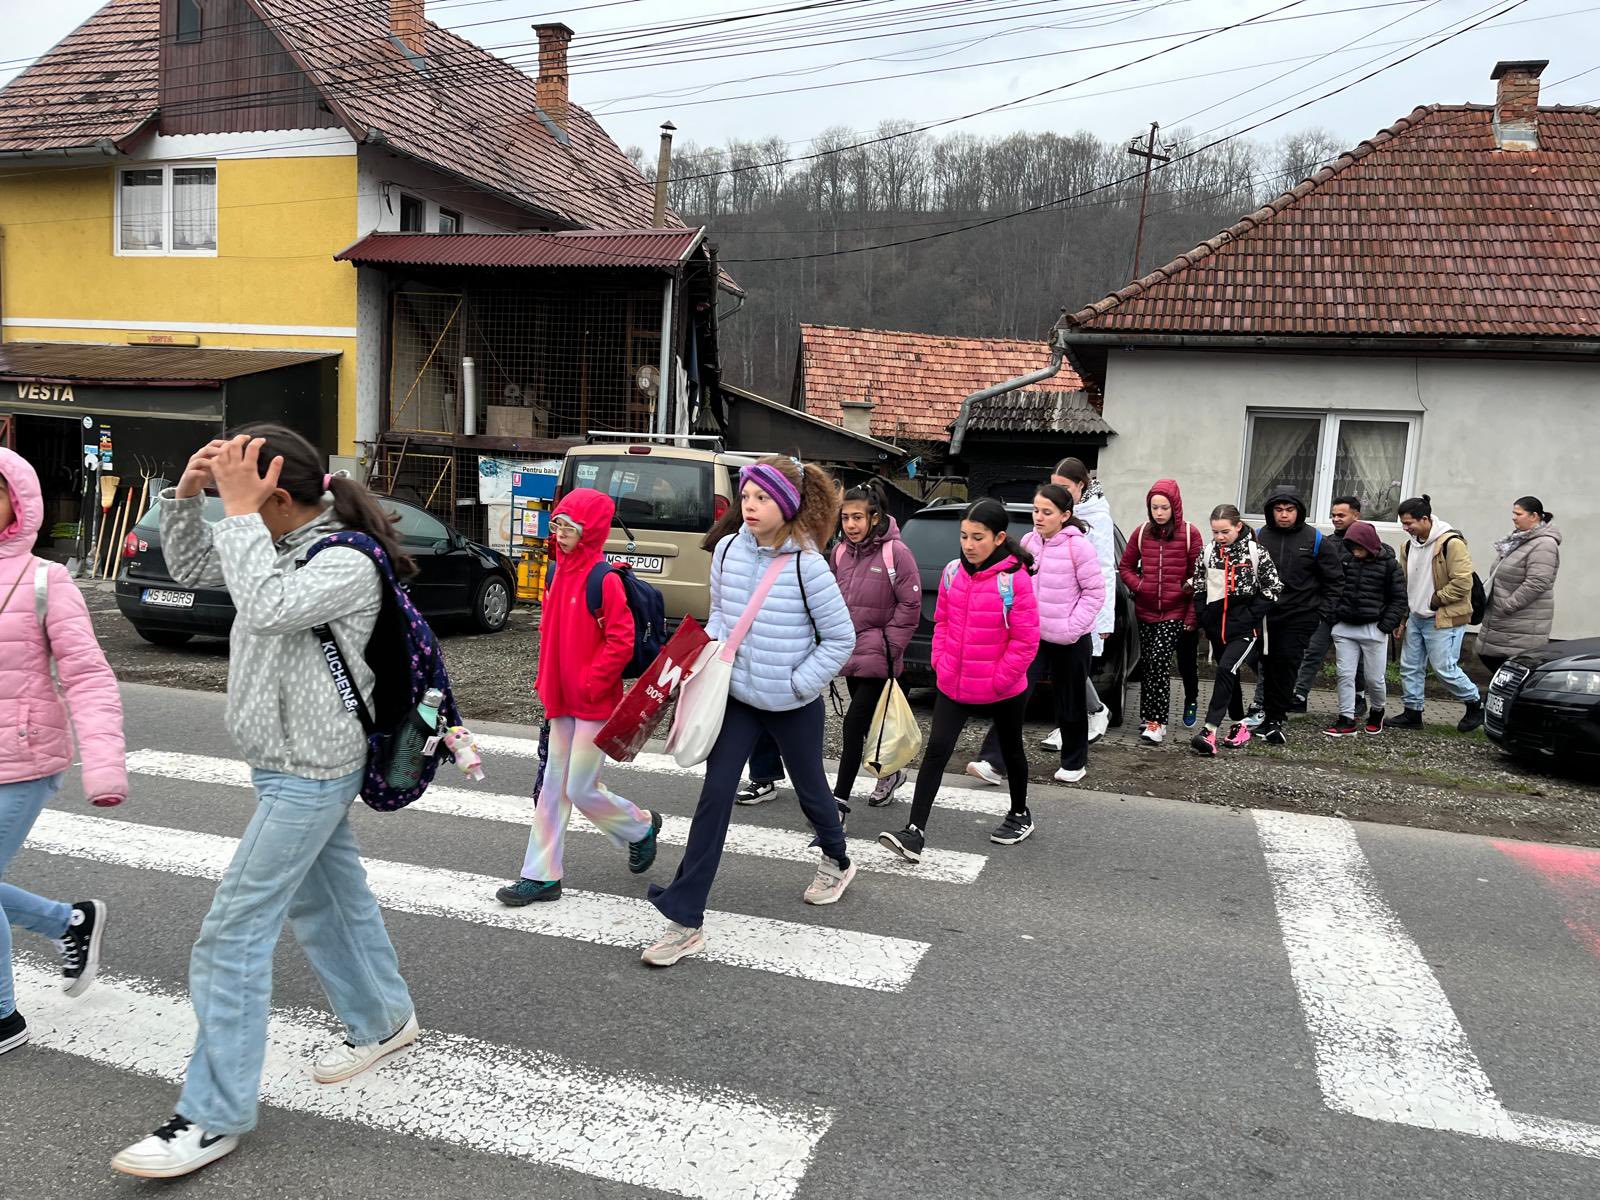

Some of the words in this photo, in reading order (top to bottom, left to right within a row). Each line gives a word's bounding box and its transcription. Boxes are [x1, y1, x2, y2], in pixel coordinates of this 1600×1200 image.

[17, 383, 74, 402] VESTA
[522, 466, 543, 474] Pentru
[637, 557, 659, 569] PUO
[645, 684, 665, 704] 100%
